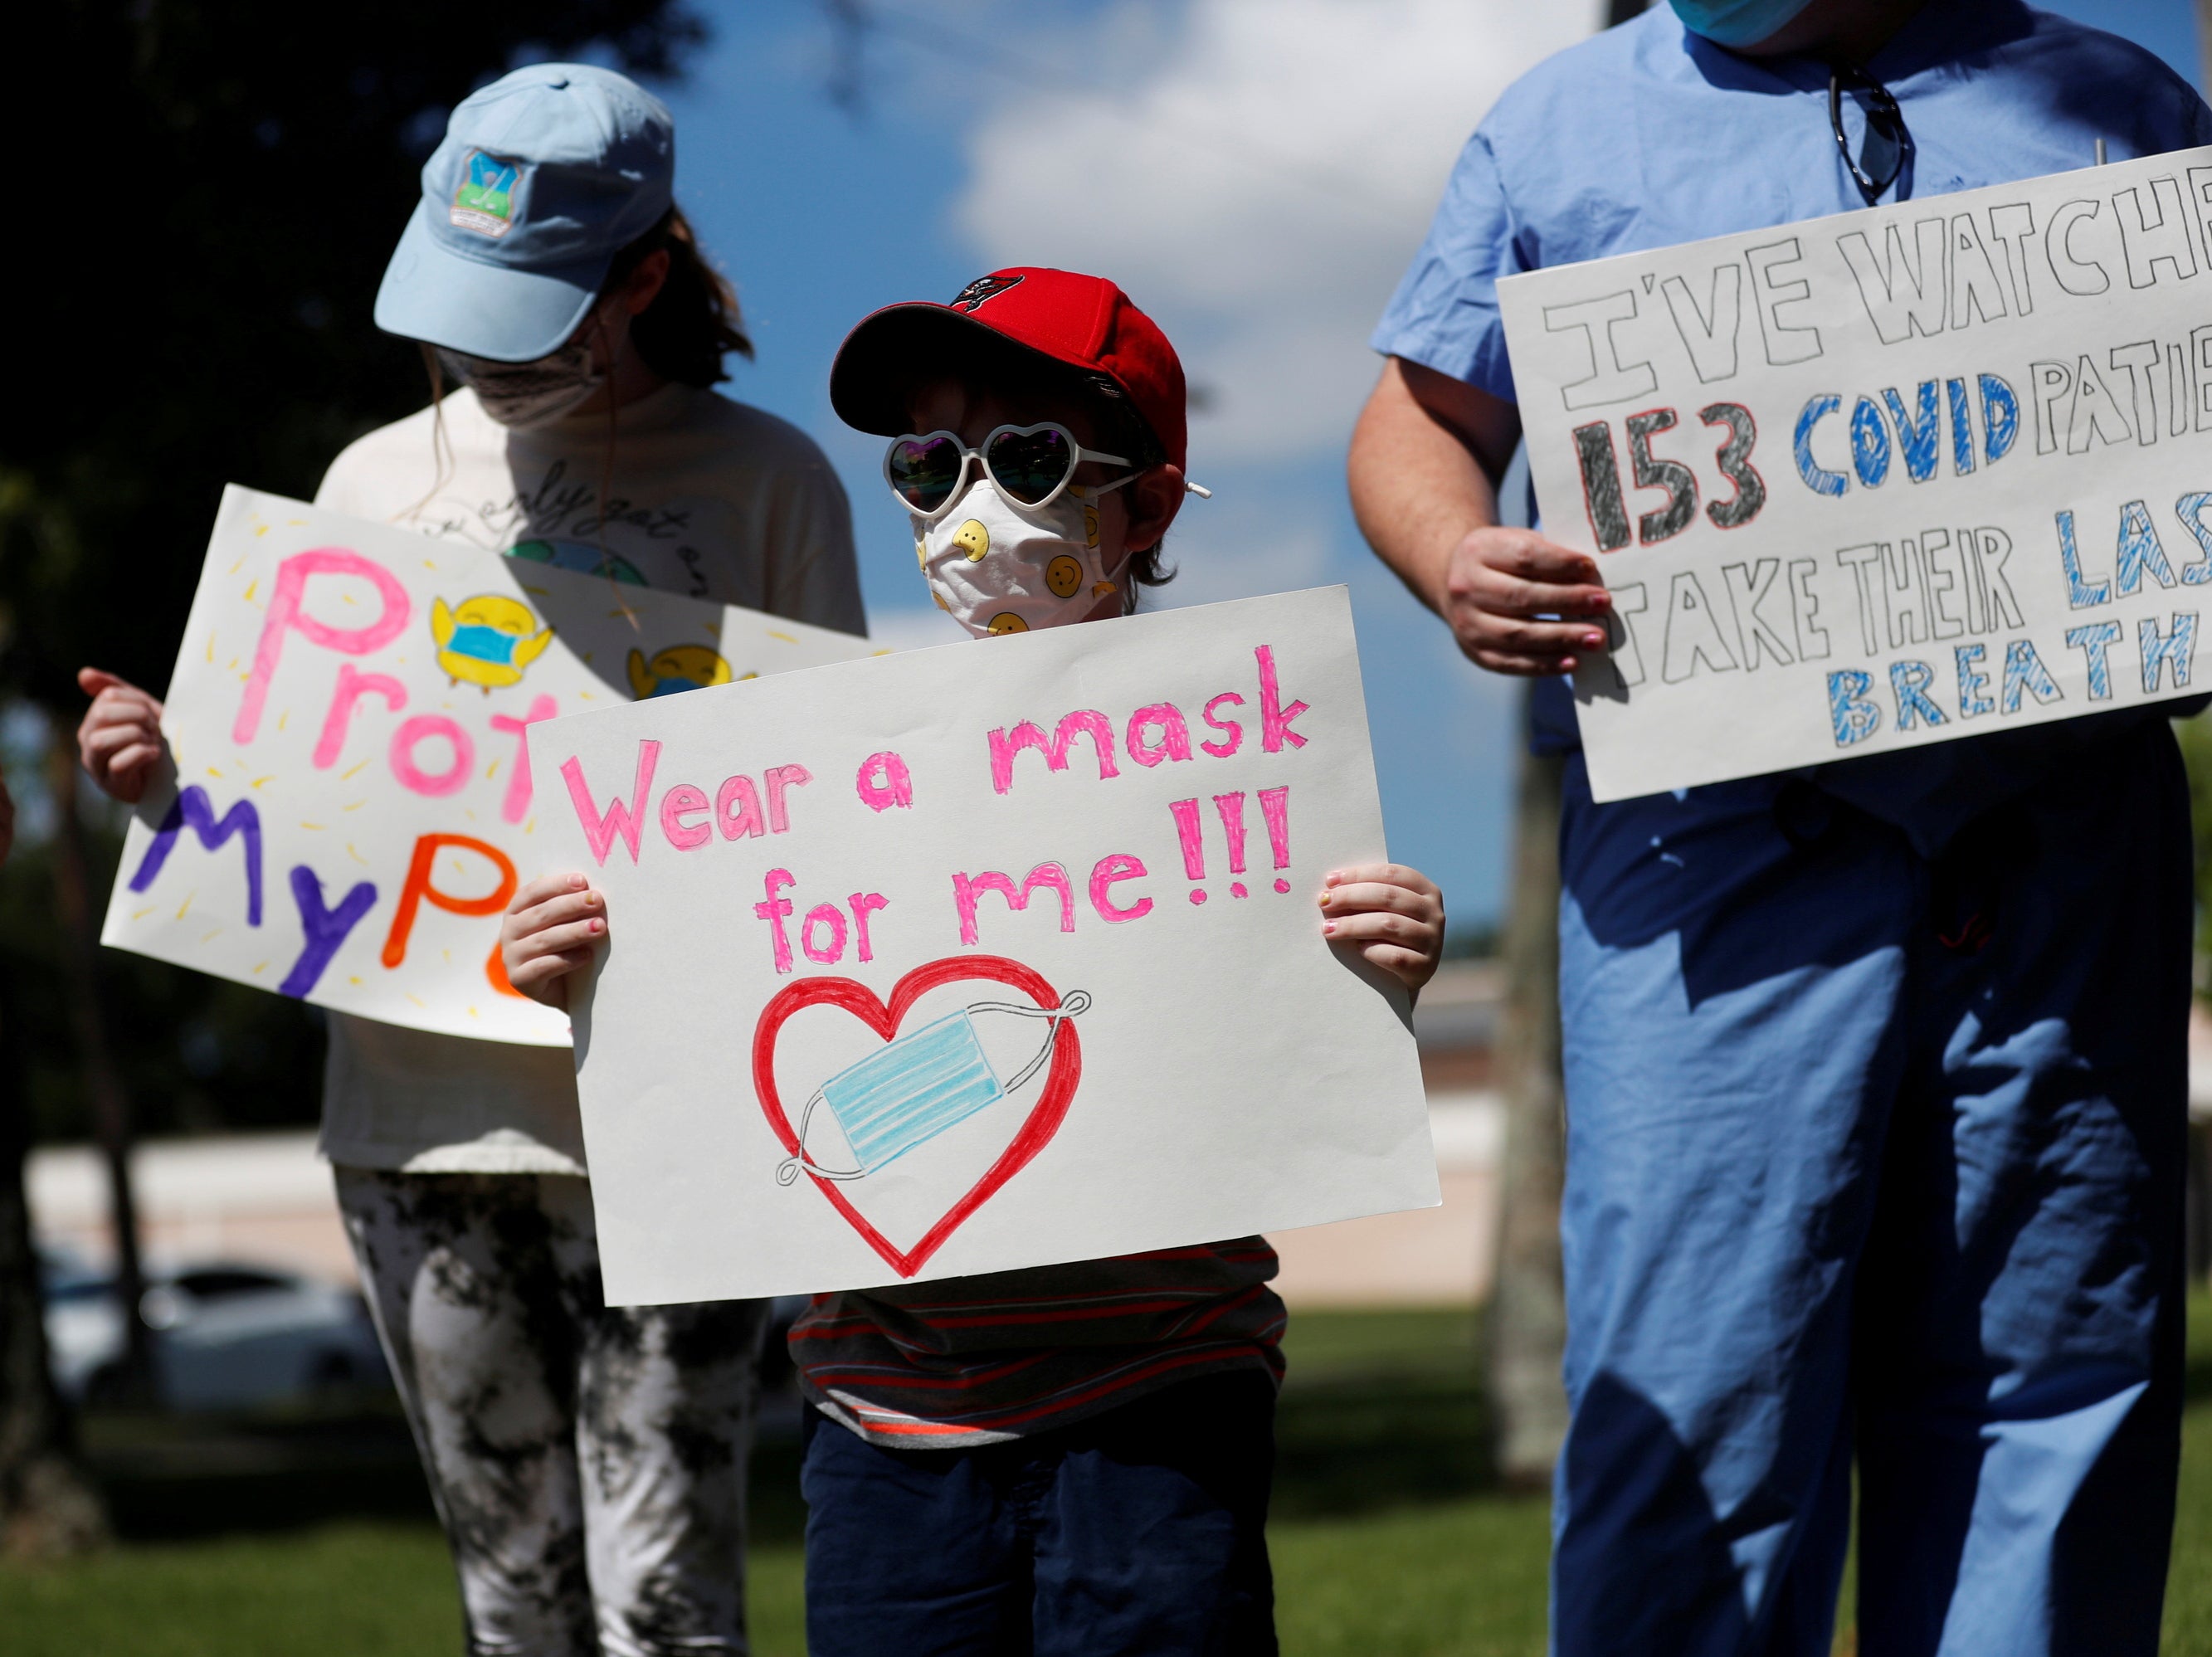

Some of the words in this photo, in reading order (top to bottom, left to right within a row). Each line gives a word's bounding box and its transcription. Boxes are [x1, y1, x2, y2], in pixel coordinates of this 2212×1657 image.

[1542, 237, 1825, 412] I'VE
[1571, 402, 1767, 553] 153
[1792, 373, 2021, 498] COVID
[1605, 558, 1830, 690] TAKE
[1836, 527, 2025, 657] THEIR
[2055, 491, 2212, 611] LAS
[1827, 611, 2199, 748] BREATH
[560, 738, 815, 867] Wear
[856, 750, 914, 811] a
[987, 644, 1309, 794] mask
[128, 783, 378, 998] My
[380, 832, 539, 1001] P
[753, 868, 890, 974] for
